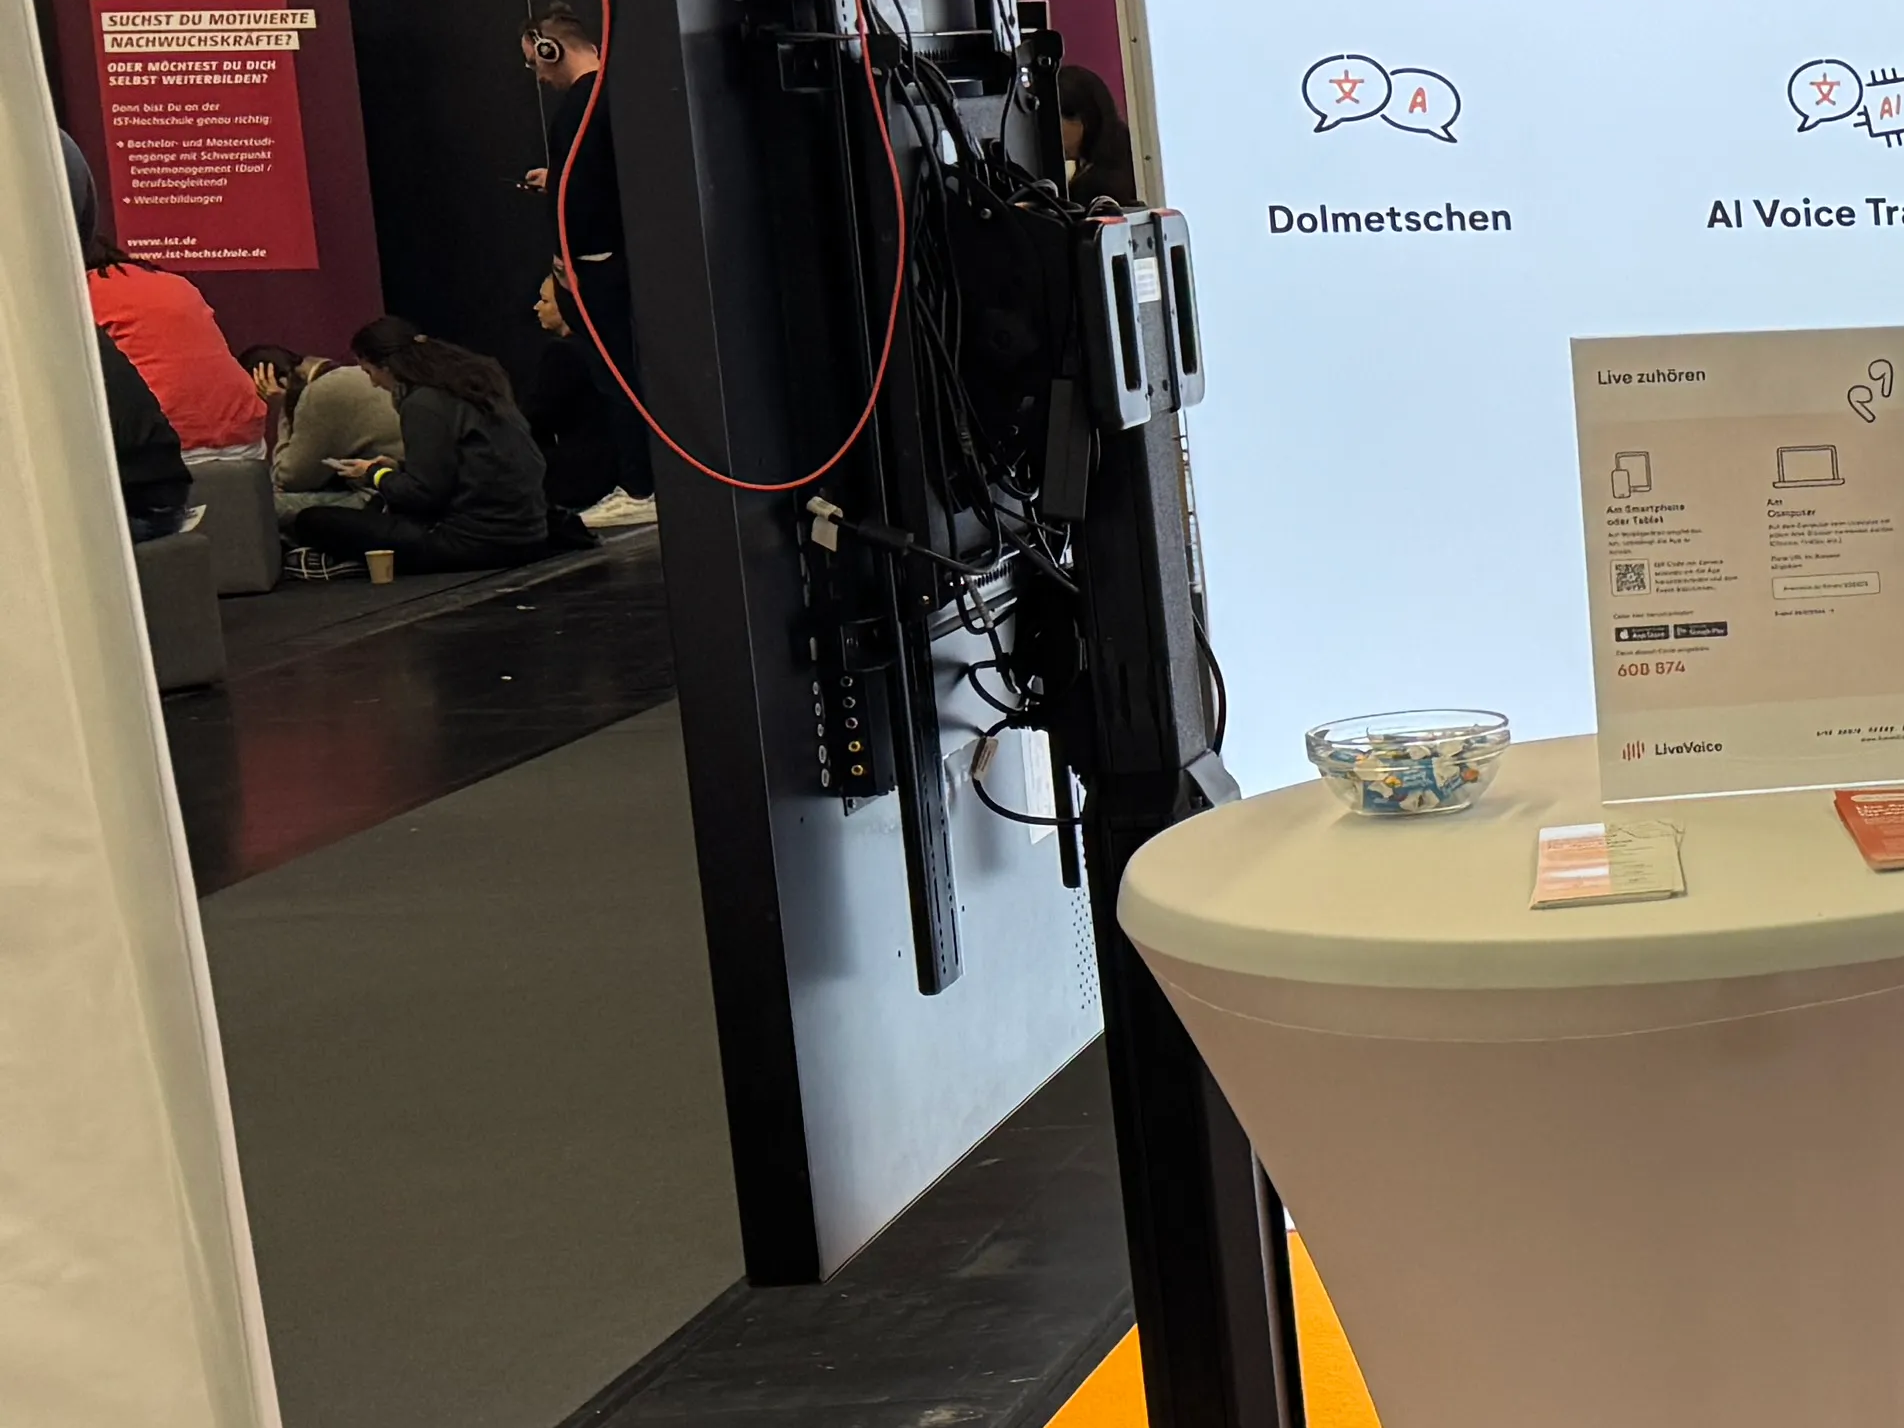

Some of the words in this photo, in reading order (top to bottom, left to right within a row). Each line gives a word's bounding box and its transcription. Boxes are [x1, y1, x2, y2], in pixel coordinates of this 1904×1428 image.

[107, 13, 174, 28] SUCHST
[179, 12, 203, 27] DU
[208, 12, 310, 26] MOTIVIERTE
[110, 32, 293, 49] NACHWUCHSKRÄFTE?
[107, 61, 143, 73] ODER
[147, 59, 220, 72] MÖCHTEST
[223, 60, 242, 71] DU
[246, 59, 277, 71] DICH
[109, 74, 159, 86] SELBST
[162, 73, 269, 85] WEITERBILDEN?
[1268, 203, 1513, 236] Dolmetschen
[1706, 199, 1745, 229] AI
[1752, 196, 1857, 229] Voice
[1597, 370, 1633, 387] Live
[1636, 368, 1707, 385] zuhören
